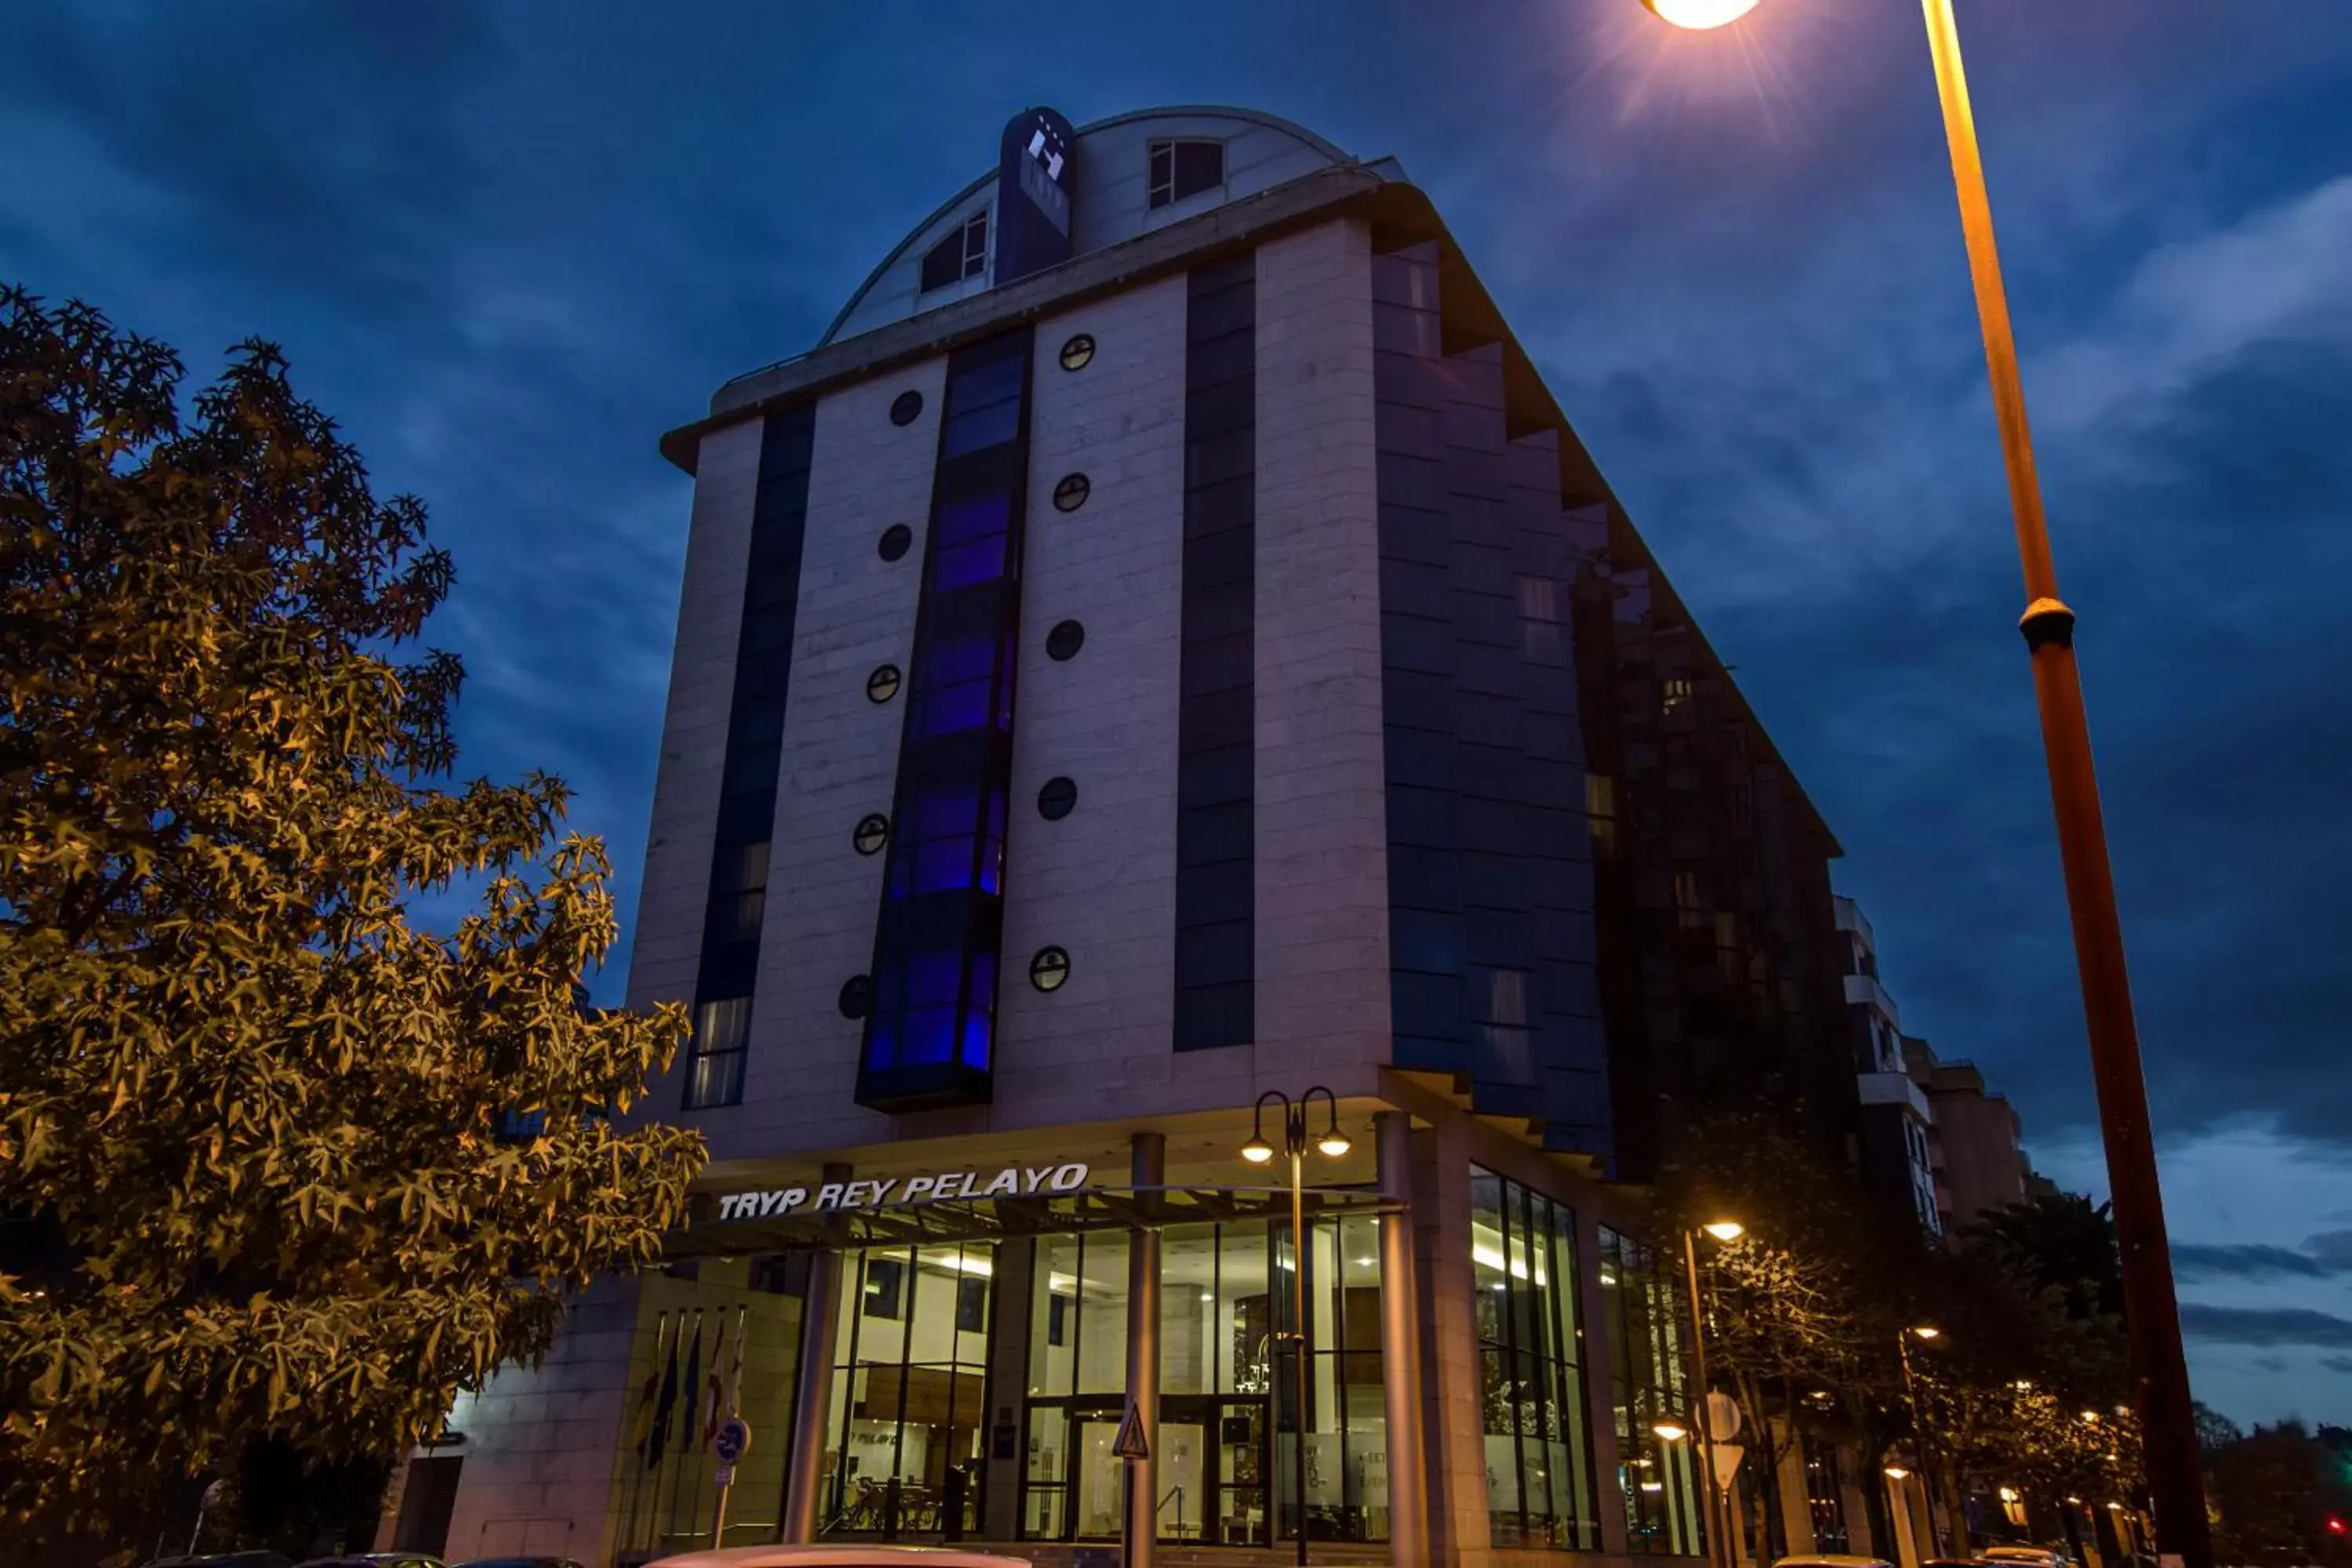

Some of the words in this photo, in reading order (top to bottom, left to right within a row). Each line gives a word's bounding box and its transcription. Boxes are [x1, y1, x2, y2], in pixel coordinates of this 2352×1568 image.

[720, 1188, 806, 1220] TRYP
[815, 1178, 898, 1210] REY
[902, 1163, 1088, 1202] PELAYO
